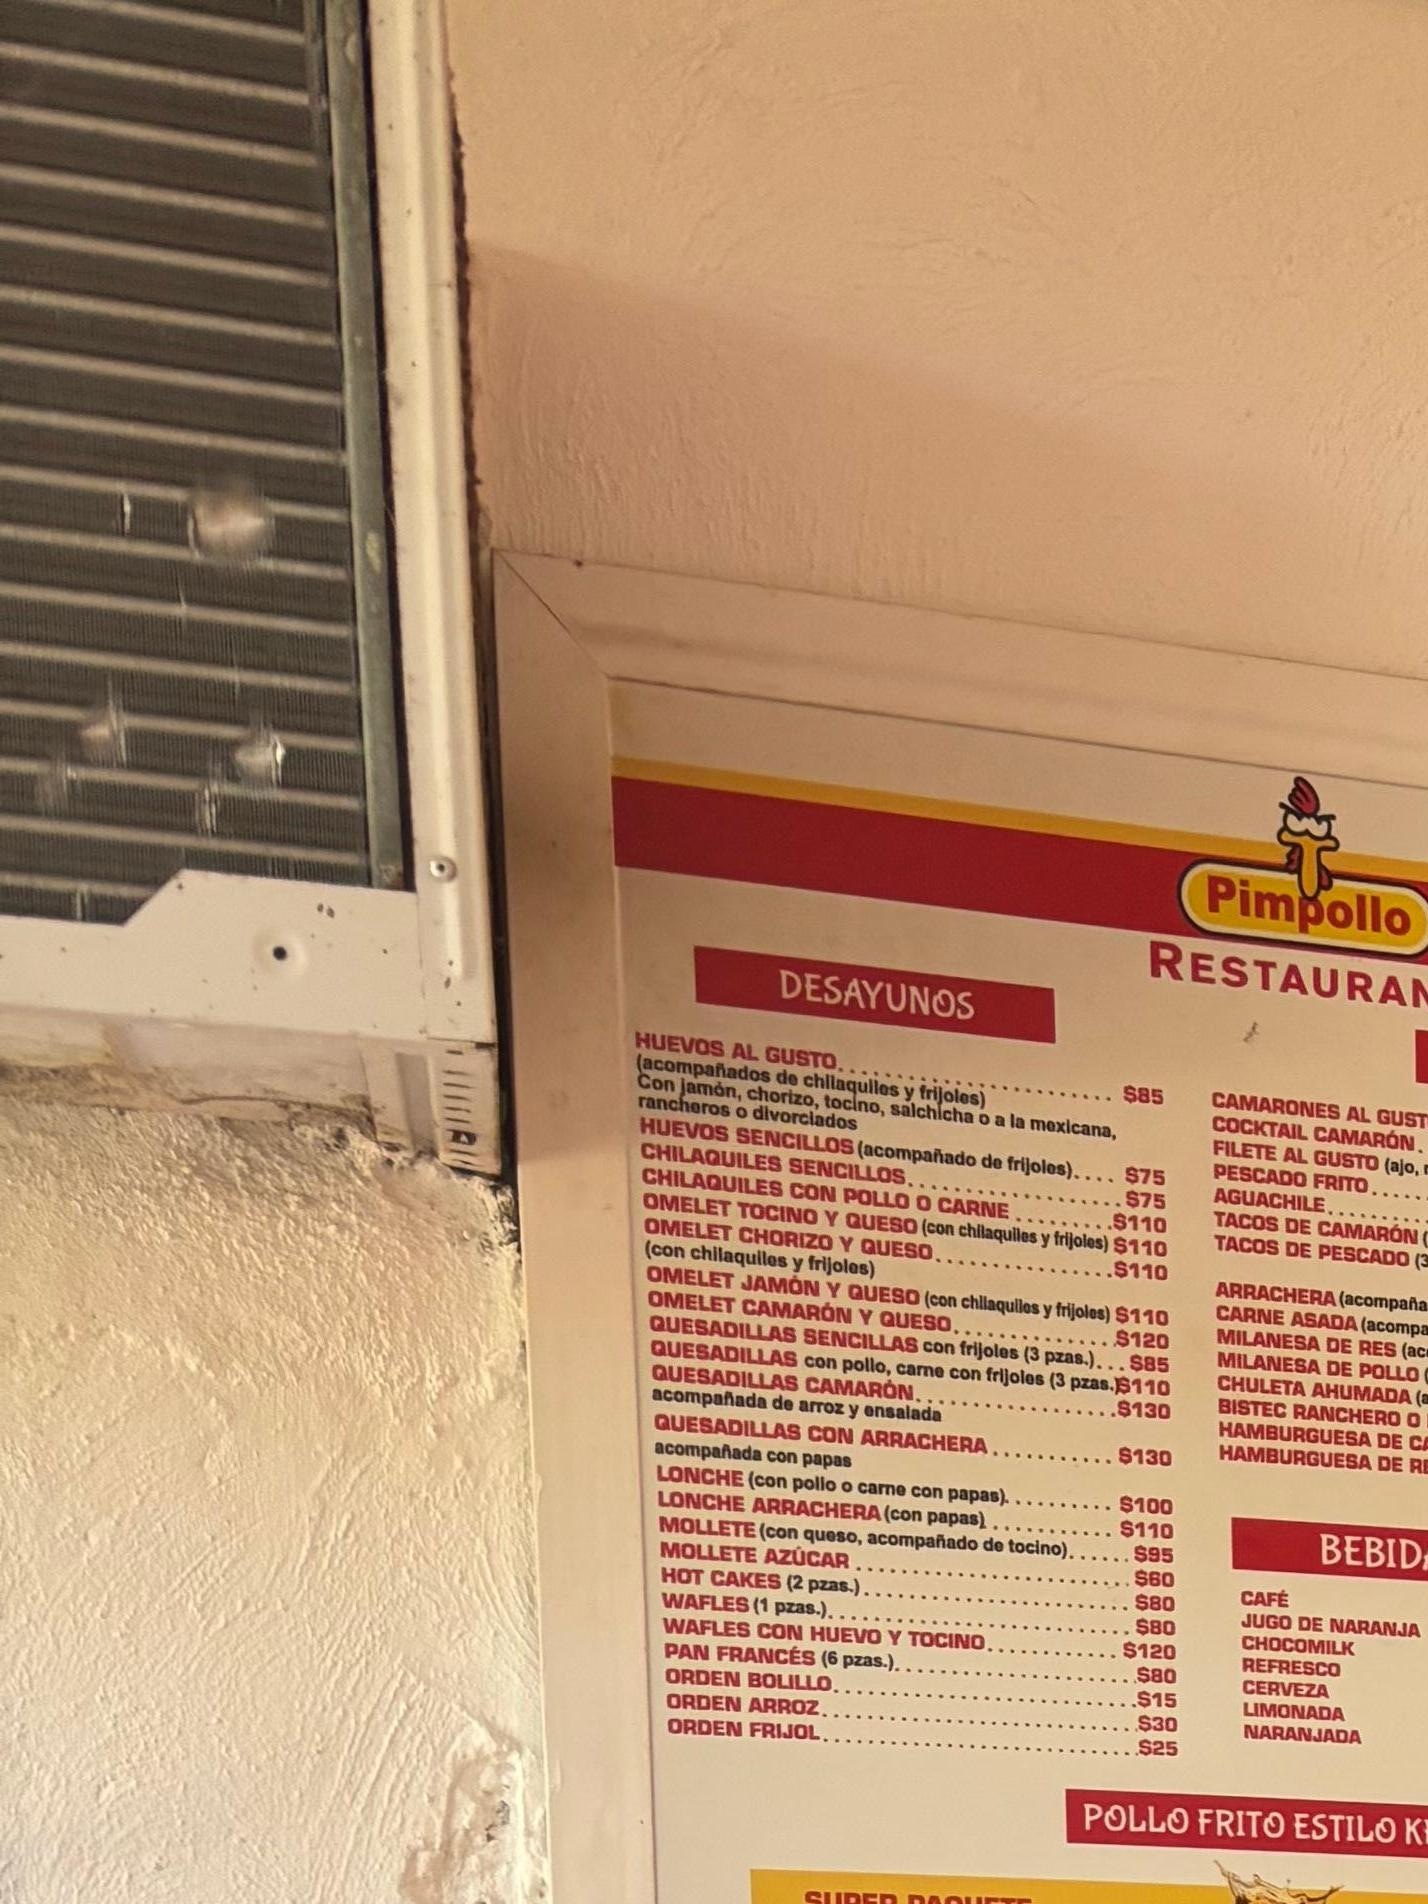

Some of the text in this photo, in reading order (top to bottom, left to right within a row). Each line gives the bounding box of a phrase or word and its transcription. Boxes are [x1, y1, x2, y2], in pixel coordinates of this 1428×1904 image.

[1206, 875, 1412, 937] Pimpollo
[780, 969, 974, 1020] DESAYUNOS
[634, 1030, 1163, 1105] HUEVOS AL GUSTO $85
[1212, 1115, 1308, 1141] COCKTAIL
[1313, 1126, 1415, 1151] CAMARÓN
[640, 1142, 1166, 1210] CHILAQUILES SENCILLOS $75
[1213, 1163, 1307, 1188] PESCADO
[1313, 1173, 1368, 1193] FRITO
[641, 1167, 1167, 1233] CHILAQUILES CON POLLO O CARNE $110
[1213, 1187, 1325, 1213] AGUACHILE
[1213, 1210, 1279, 1232] TACOS
[1285, 1217, 1311, 1235] DE
[1317, 1220, 1418, 1245] CAMARÓN
[644, 1217, 1168, 1281] OMELET CHORIZO Y QUESO $110
[1216, 1304, 1284, 1326] CARNE
[1290, 1311, 1358, 1331] ASADA
[651, 1363, 1171, 1419] QUESADILLAS CAMARÓN $130
[654, 1413, 1172, 1466] QUESADILLAS CON ARRACHERA $130
[660, 1541, 1174, 1588] MOLLETE AZÚCAR $60
[1240, 1589, 1289, 1608] CAFÉ
[662, 1617, 1176, 1660] WAFLES CON HUEVO Y TOCINO $120
[1241, 1613, 1292, 1630] JUGO
[1298, 1616, 1323, 1632] DE
[1329, 1618, 1421, 1638] NARANJA
[1241, 1635, 1355, 1656] CHOCOMILK
[1242, 1657, 1341, 1677] REFRESCO
[665, 1668, 1177, 1708] ORDEN BOLILLO $15
[1242, 1679, 1329, 1698] CERVEZA
[666, 1693, 1177, 1732] ORDEN ARROZ $30
[1243, 1702, 1345, 1721] LIMONADA
[667, 1718, 1178, 1756] ORDEN FRIJOL $25
[1243, 1724, 1362, 1744] NARANJADA
[1083, 1803, 1189, 1834] POLLO
[1198, 1808, 1285, 1838] FRITO
[1294, 1812, 1396, 1843] ESTILO
